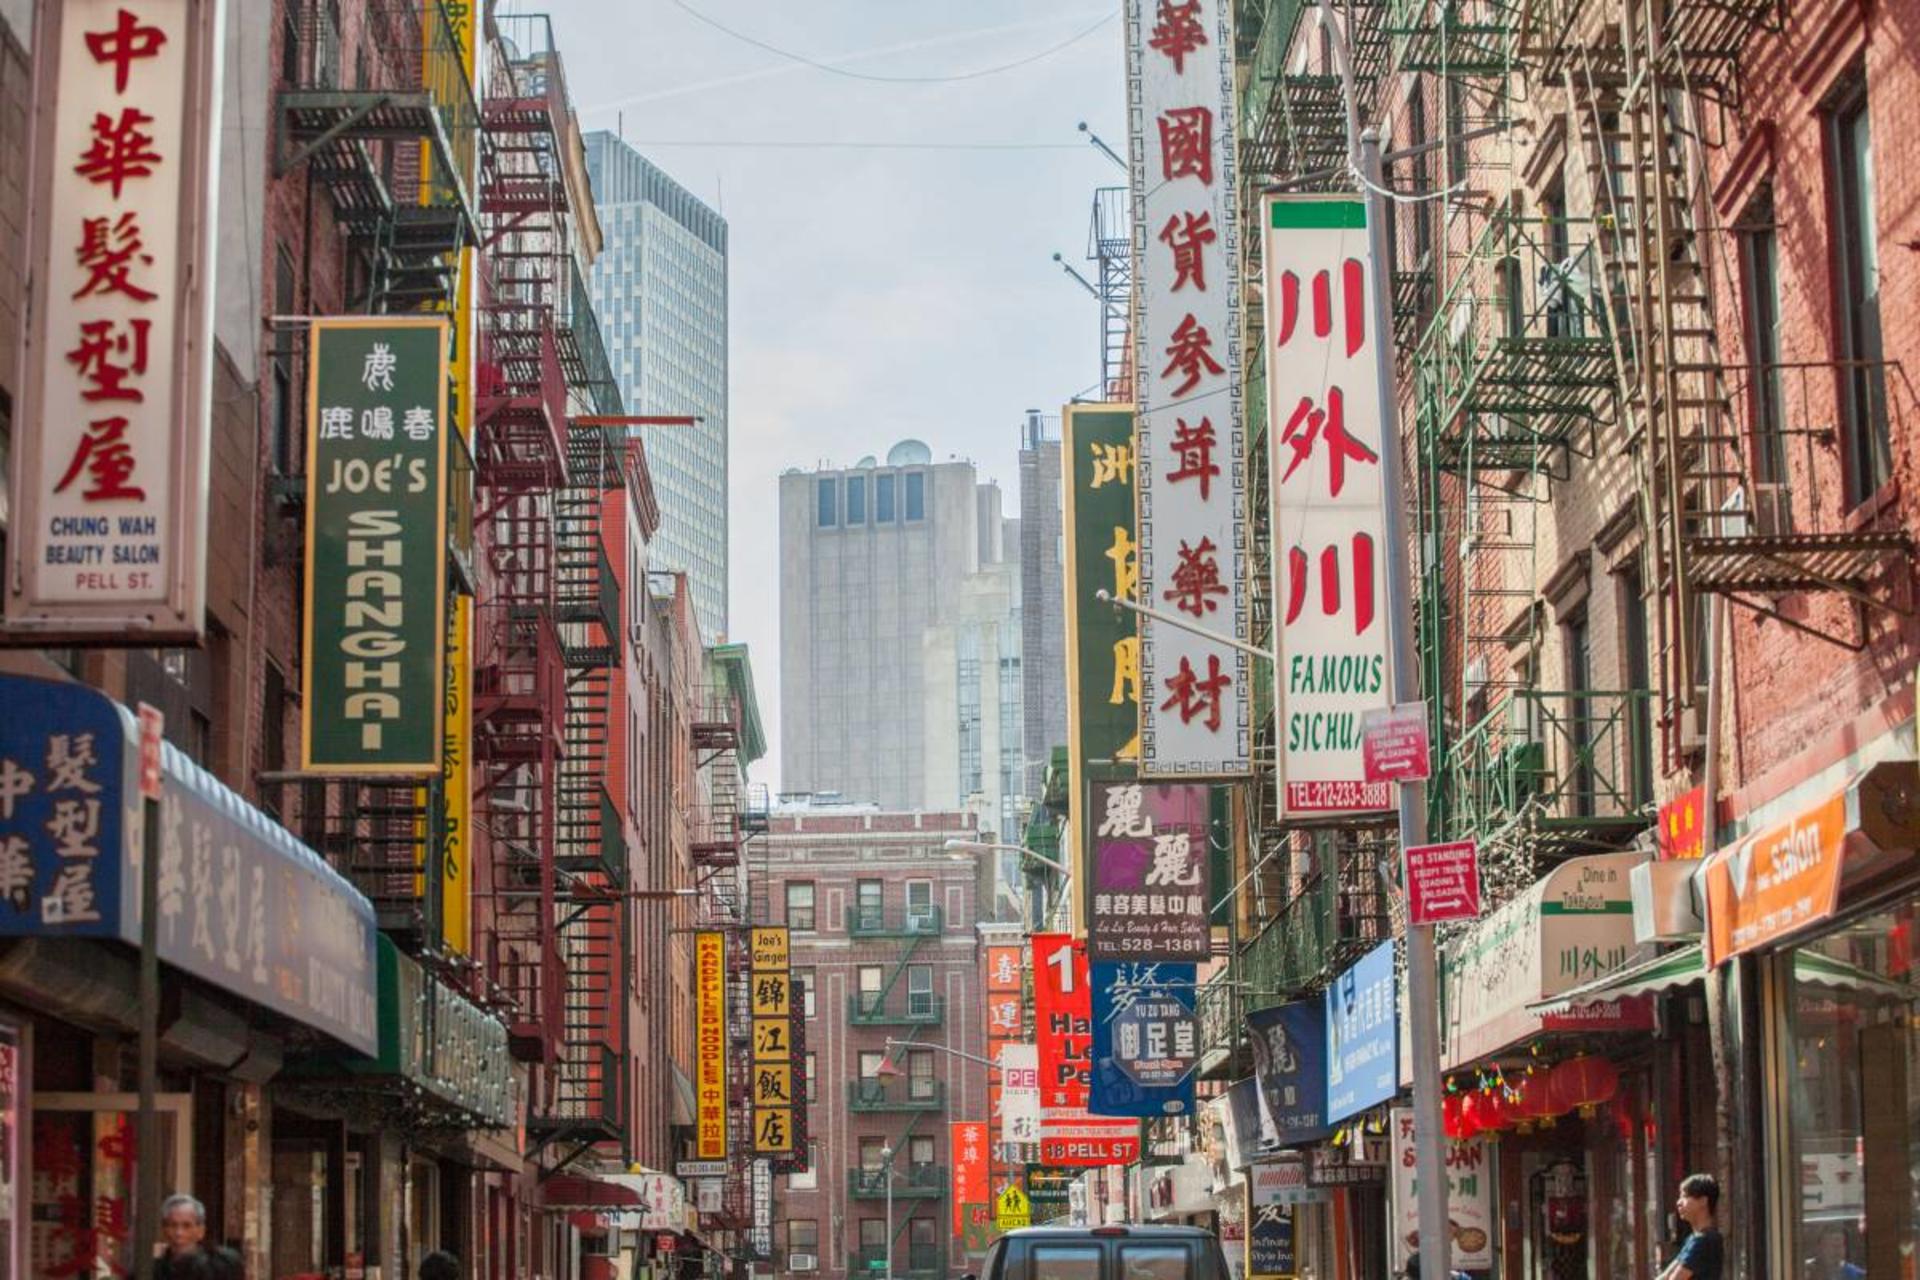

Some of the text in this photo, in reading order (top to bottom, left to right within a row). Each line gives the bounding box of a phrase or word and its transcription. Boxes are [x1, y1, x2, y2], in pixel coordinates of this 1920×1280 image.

[53, 8, 168, 503] 中華髮型屋
[320, 405, 436, 441] 鹿鳴春
[1278, 257, 1378, 636] 川外川
[326, 453, 427, 493] JOE'S
[50, 516, 155, 536] CHUNG WAH
[46, 545, 159, 564] BEAUTY SALON
[76, 573, 152, 590] PELL ST.
[340, 510, 406, 750] SHANGHAI
[1290, 654, 1383, 694] FAMOUS
[1411, 850, 1472, 865] NO STANDING
[1770, 818, 1822, 886] salon
[758, 934, 782, 946] Joe's
[756, 976, 790, 1147] 錦江飯店
[1068, 1143, 1108, 1158] PELL
[1112, 1143, 1133, 1158] ST
